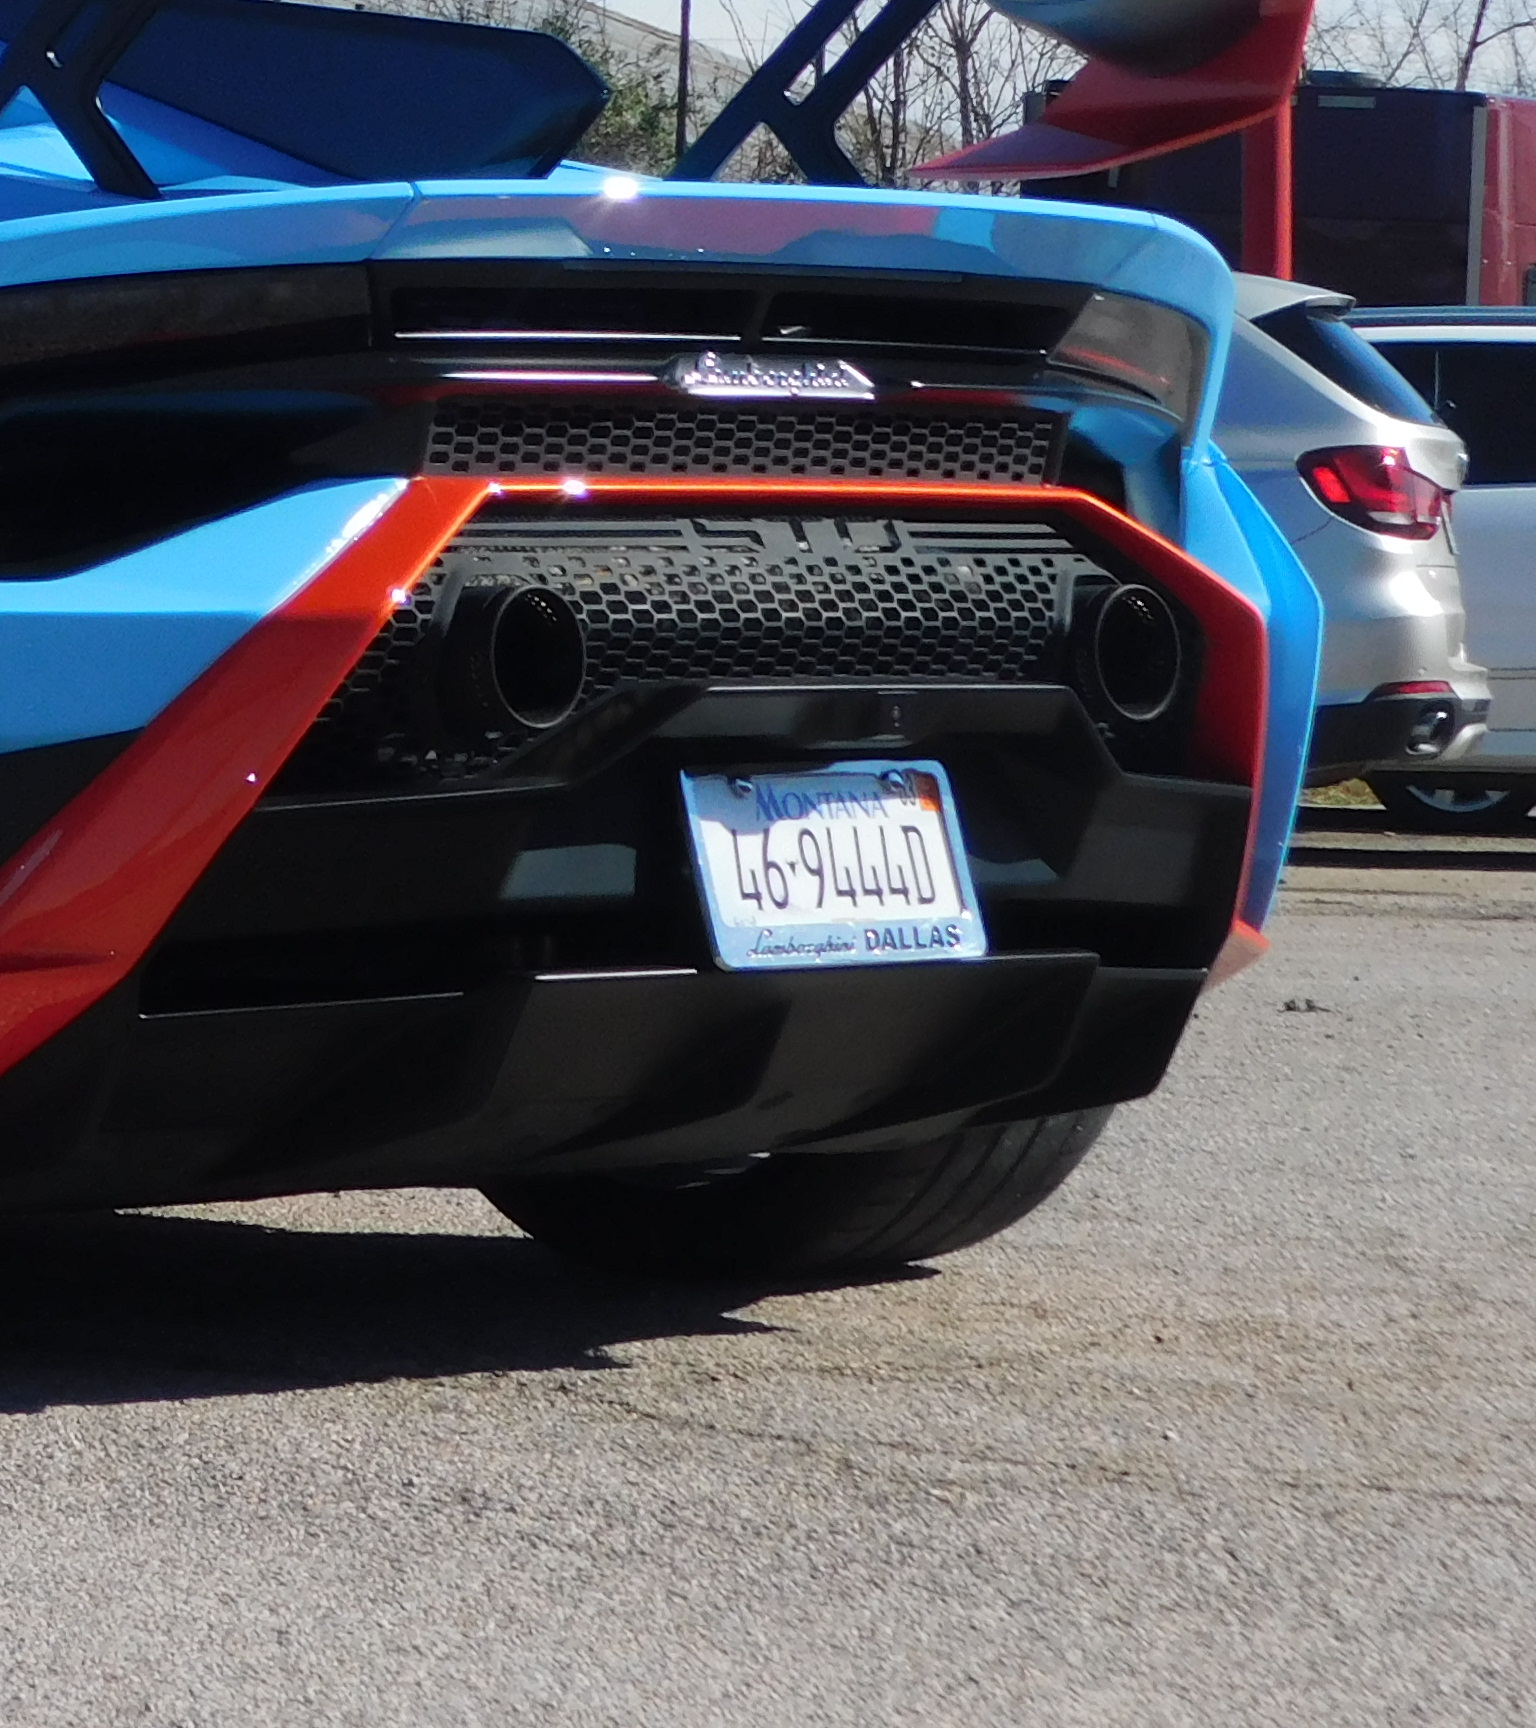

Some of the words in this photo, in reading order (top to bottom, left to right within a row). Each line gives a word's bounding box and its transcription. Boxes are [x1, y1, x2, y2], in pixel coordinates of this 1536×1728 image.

[755, 783, 889, 822] MONTANA
[746, 928, 856, 959] Lamborghini
[864, 923, 962, 952] DALLAS
